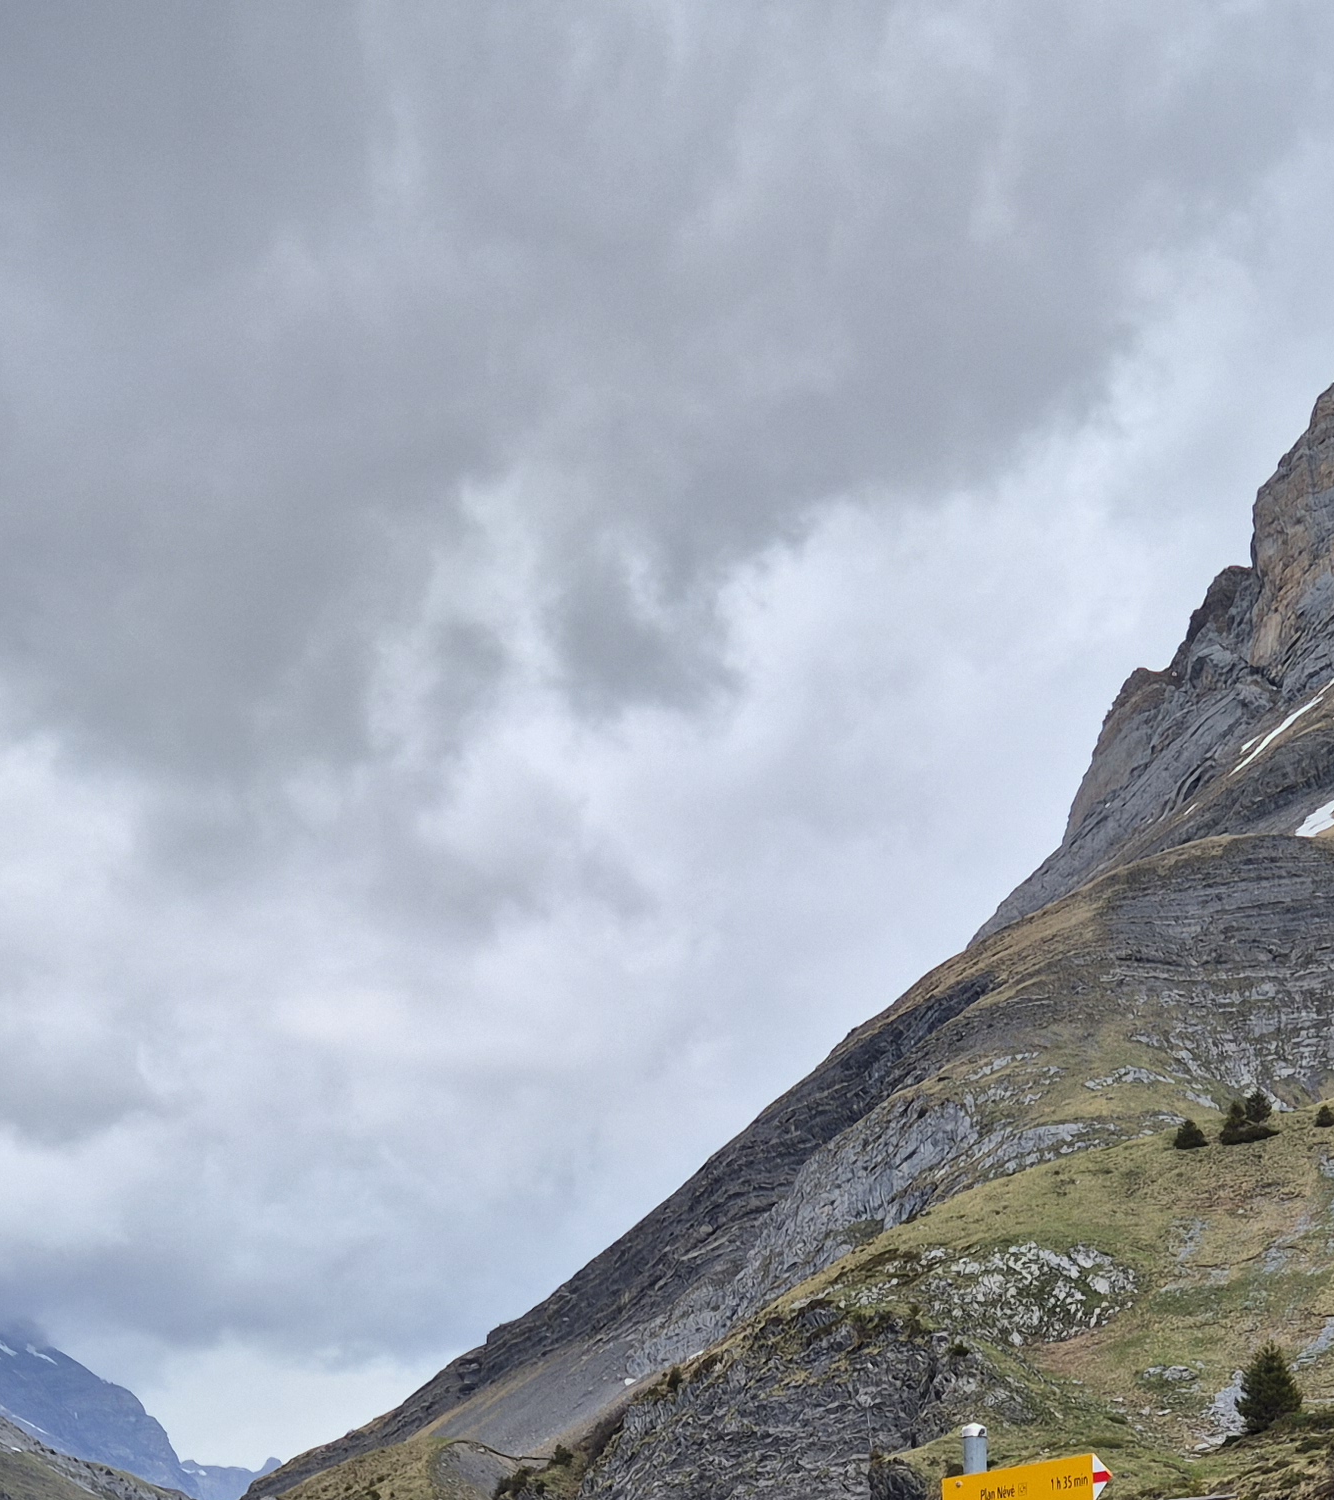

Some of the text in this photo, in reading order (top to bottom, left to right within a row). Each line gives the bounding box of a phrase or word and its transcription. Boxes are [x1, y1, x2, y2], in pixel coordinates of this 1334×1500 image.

[1056, 1476, 1062, 1490] h
[1063, 1475, 1073, 1489] 35
[1073, 1474, 1088, 1488] min
[997, 1484, 1016, 1499] Névé
